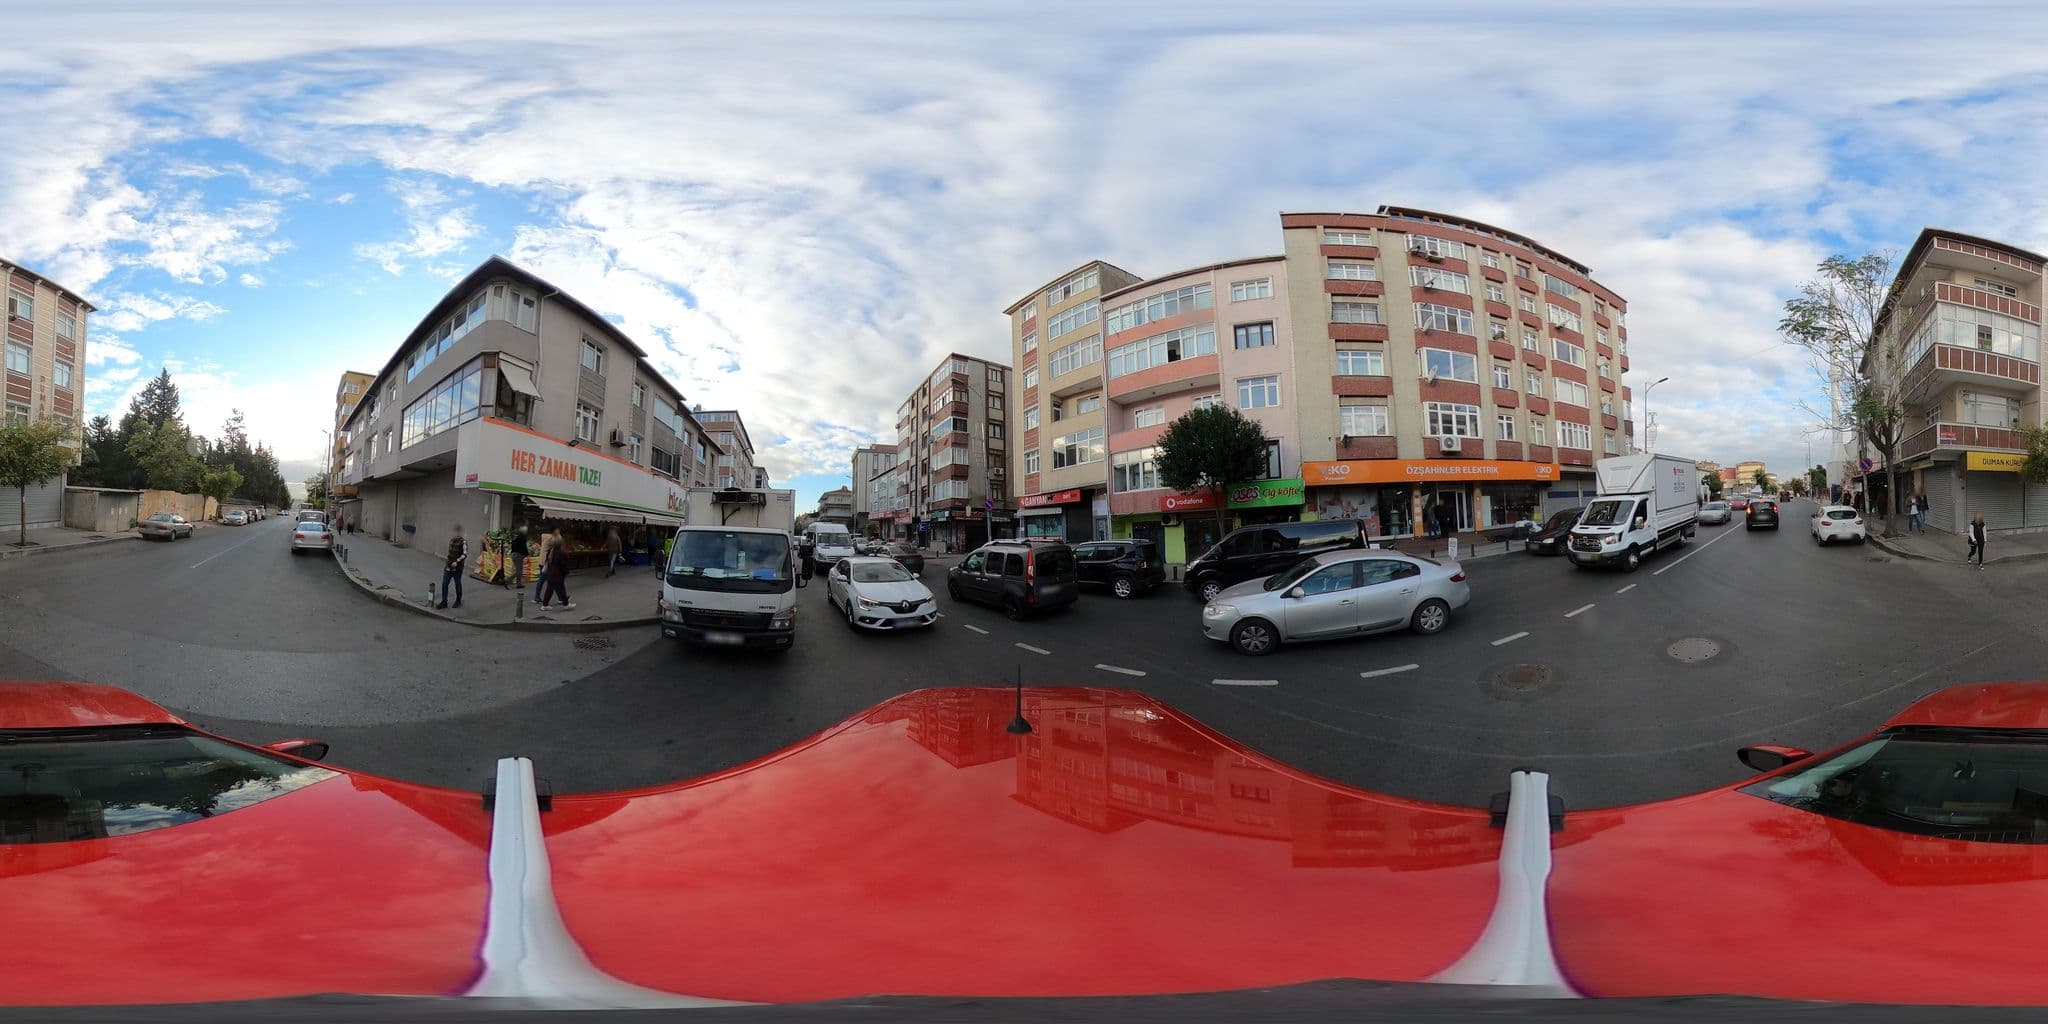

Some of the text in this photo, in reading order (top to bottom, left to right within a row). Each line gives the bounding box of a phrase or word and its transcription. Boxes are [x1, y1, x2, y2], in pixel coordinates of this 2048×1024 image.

[511, 449, 601, 487] HER ZAMAN TAZE!
[1406, 464, 1461, 475] ÖZŞAHİNLER
[1025, 495, 1047, 506] GANYAN
